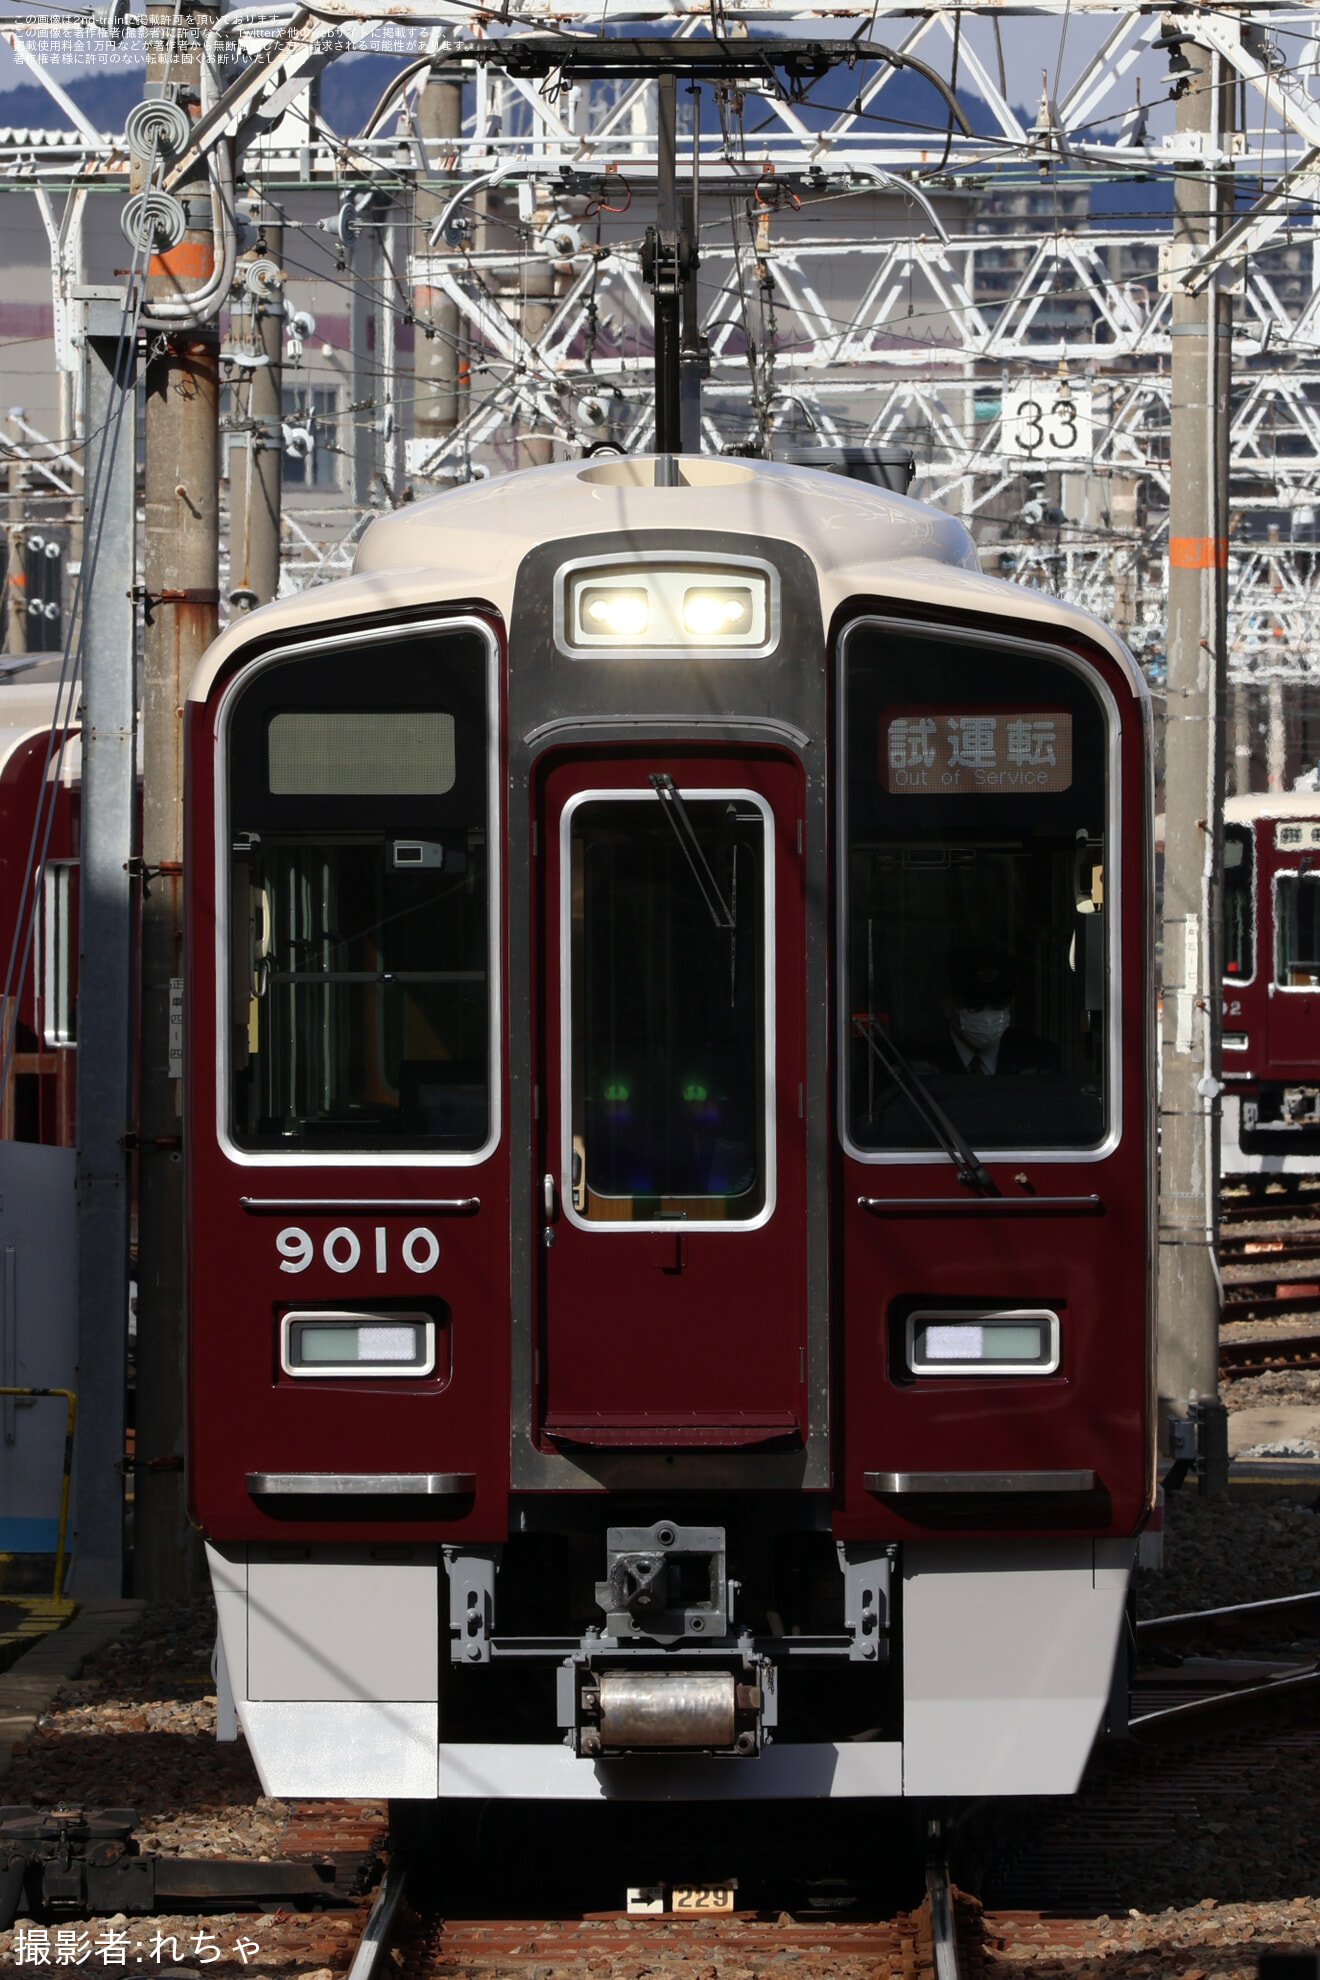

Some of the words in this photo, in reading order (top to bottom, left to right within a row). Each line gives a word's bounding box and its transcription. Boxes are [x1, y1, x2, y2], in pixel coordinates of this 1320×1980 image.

[1015, 400, 1077, 449] 33
[888, 718, 1056, 767] 試運転
[896, 770, 927, 785] Out
[941, 770, 960, 785] of
[975, 770, 1049, 785] Service
[275, 1227, 440, 1273] 9010
[678, 1886, 729, 1907] 229
